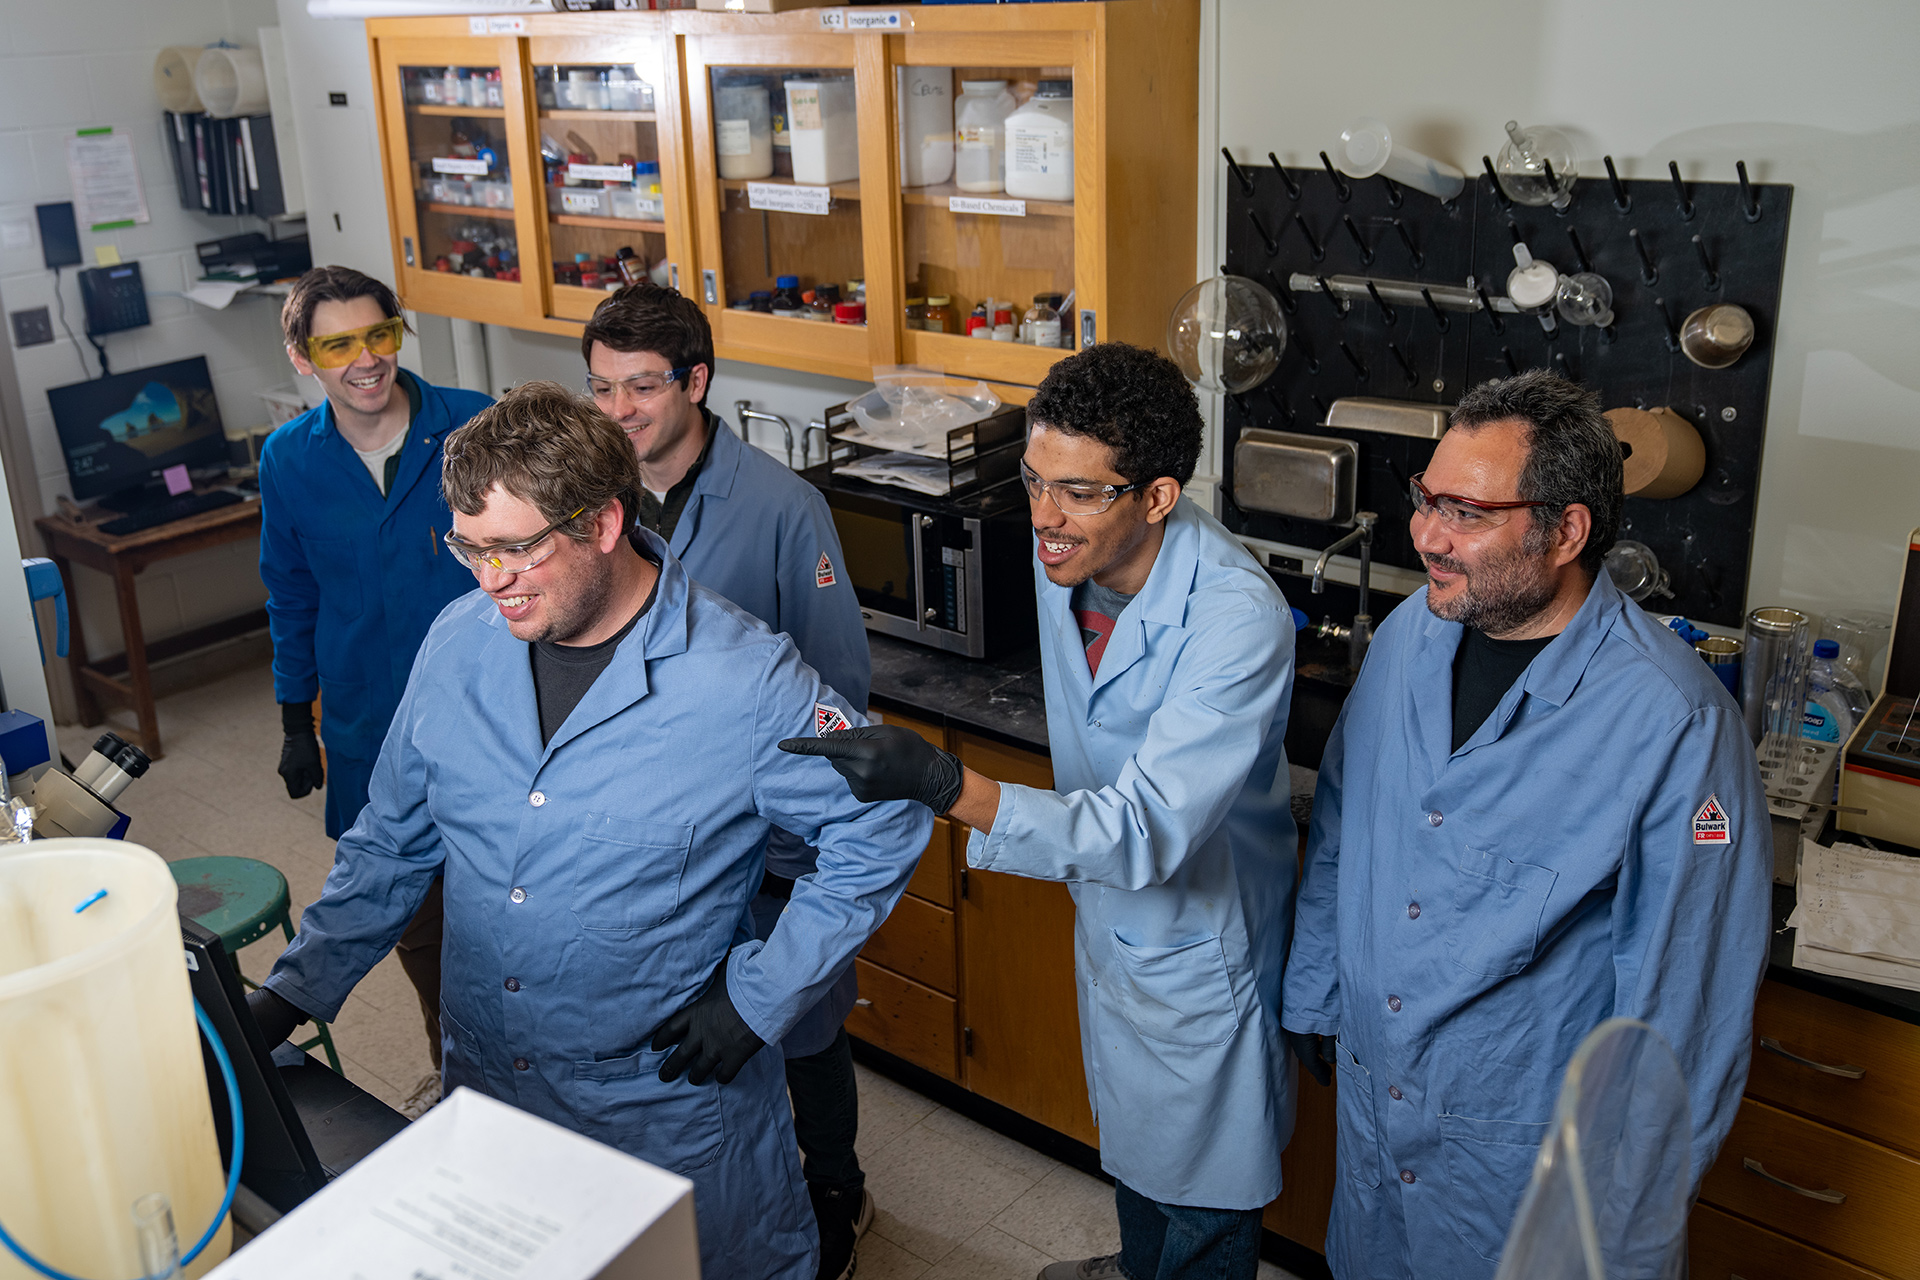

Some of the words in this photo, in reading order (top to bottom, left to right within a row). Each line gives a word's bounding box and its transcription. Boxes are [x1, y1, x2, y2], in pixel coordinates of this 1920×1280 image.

[822, 15, 834, 25] LC
[849, 15, 887, 28] Inorganic
[751, 185, 766, 195] Large
[767, 186, 792, 197] Inorganic
[795, 189, 822, 199] Overflow
[752, 198, 767, 207] Small
[769, 199, 795, 210] Inorganic
[951, 200, 981, 210] Si-Based
[983, 202, 1019, 213] Chemicals
[819, 715, 842, 738] Bulwark
[1803, 715, 1823, 726] soap
[1695, 822, 1726, 831] Bulwark
